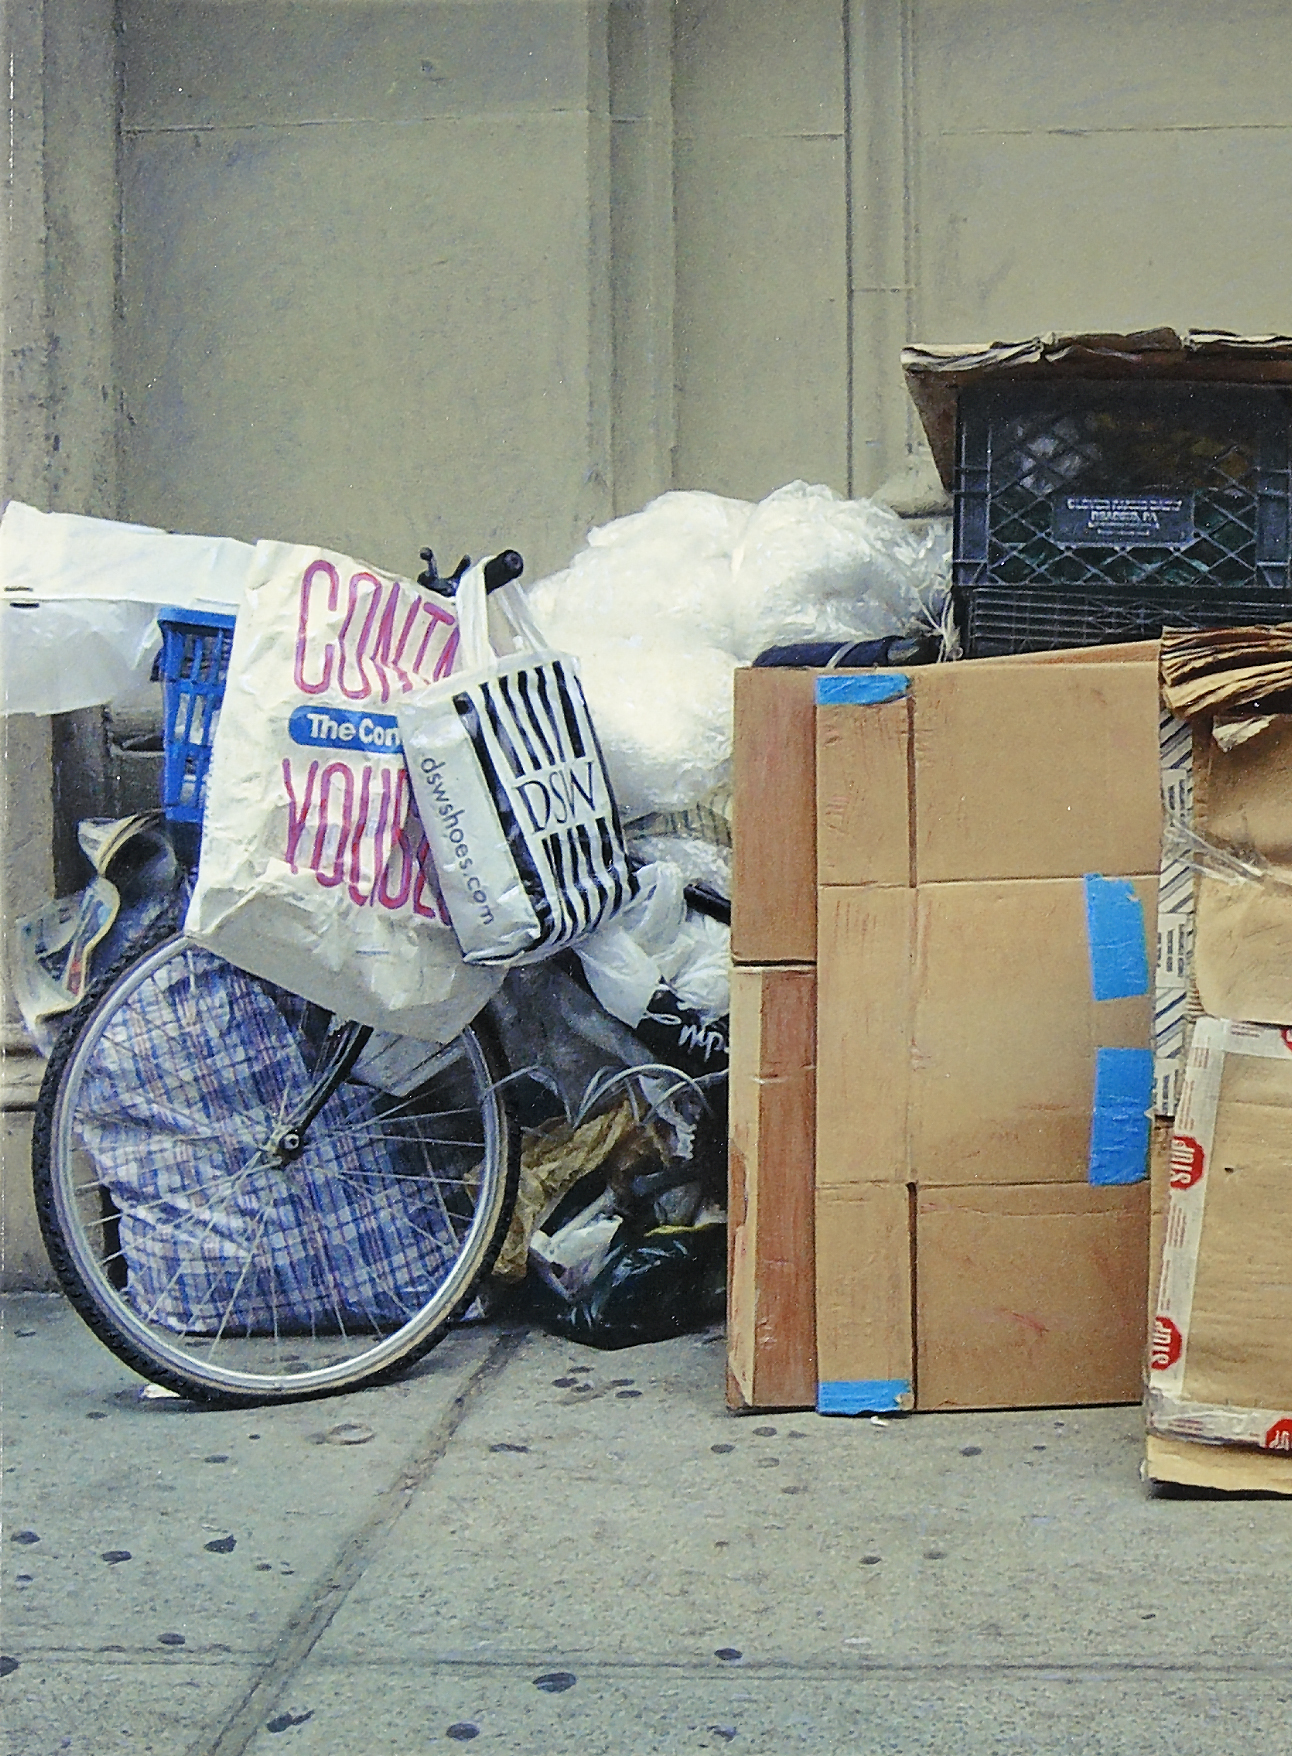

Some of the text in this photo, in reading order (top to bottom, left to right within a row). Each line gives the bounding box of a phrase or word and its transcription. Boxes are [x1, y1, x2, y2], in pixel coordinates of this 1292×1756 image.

[306, 712, 356, 742] The
[511, 759, 597, 836] DSW
[420, 756, 495, 926] dswshoes.com
